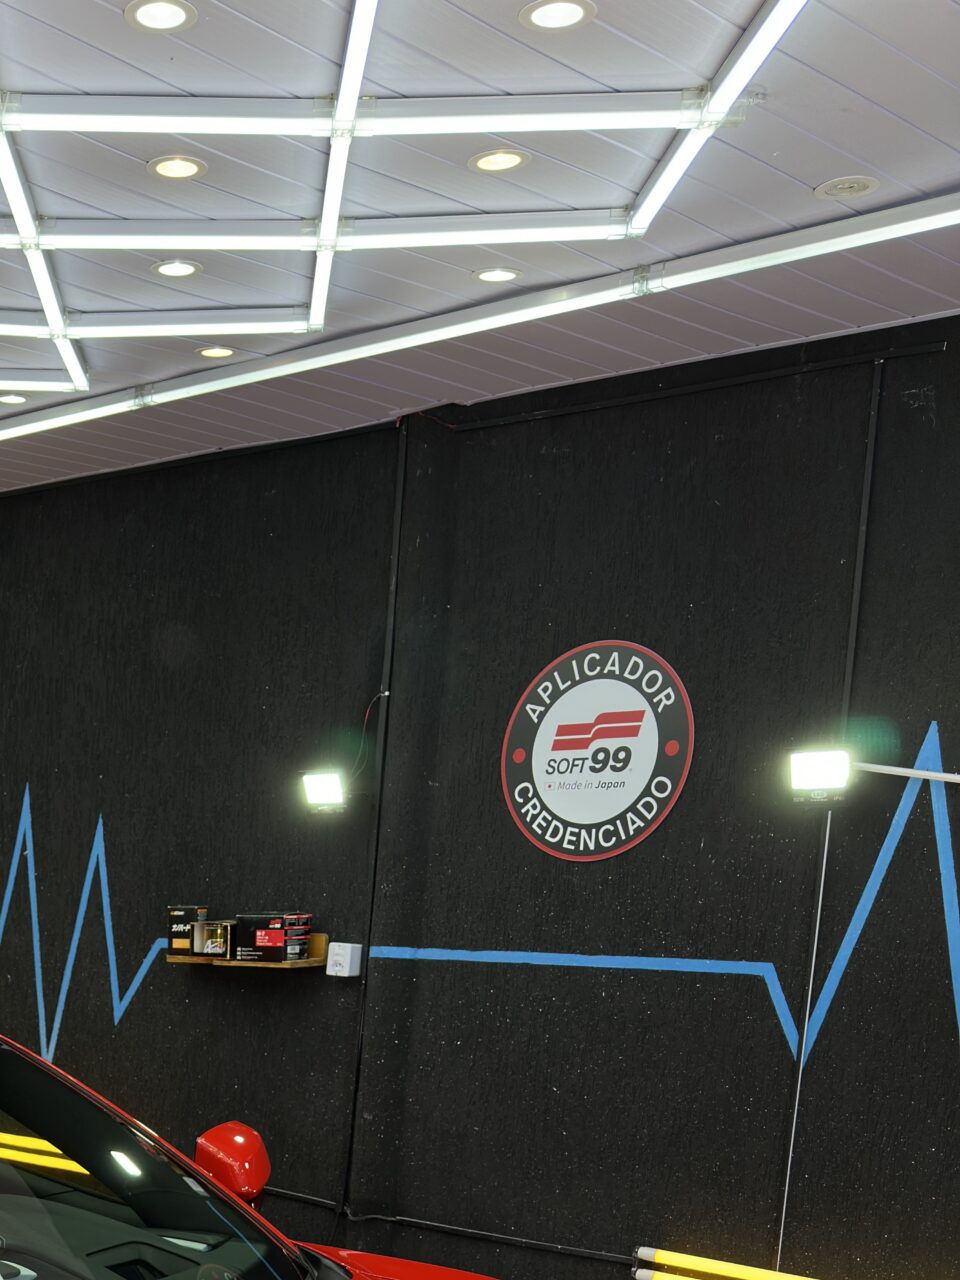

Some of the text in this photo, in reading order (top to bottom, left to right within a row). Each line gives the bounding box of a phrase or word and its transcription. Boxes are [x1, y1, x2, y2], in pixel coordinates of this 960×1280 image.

[525, 651, 676, 723] APLICADOR
[514, 775, 672, 851] CREDENCIADO
[557, 780, 626, 791] Made in Japan
